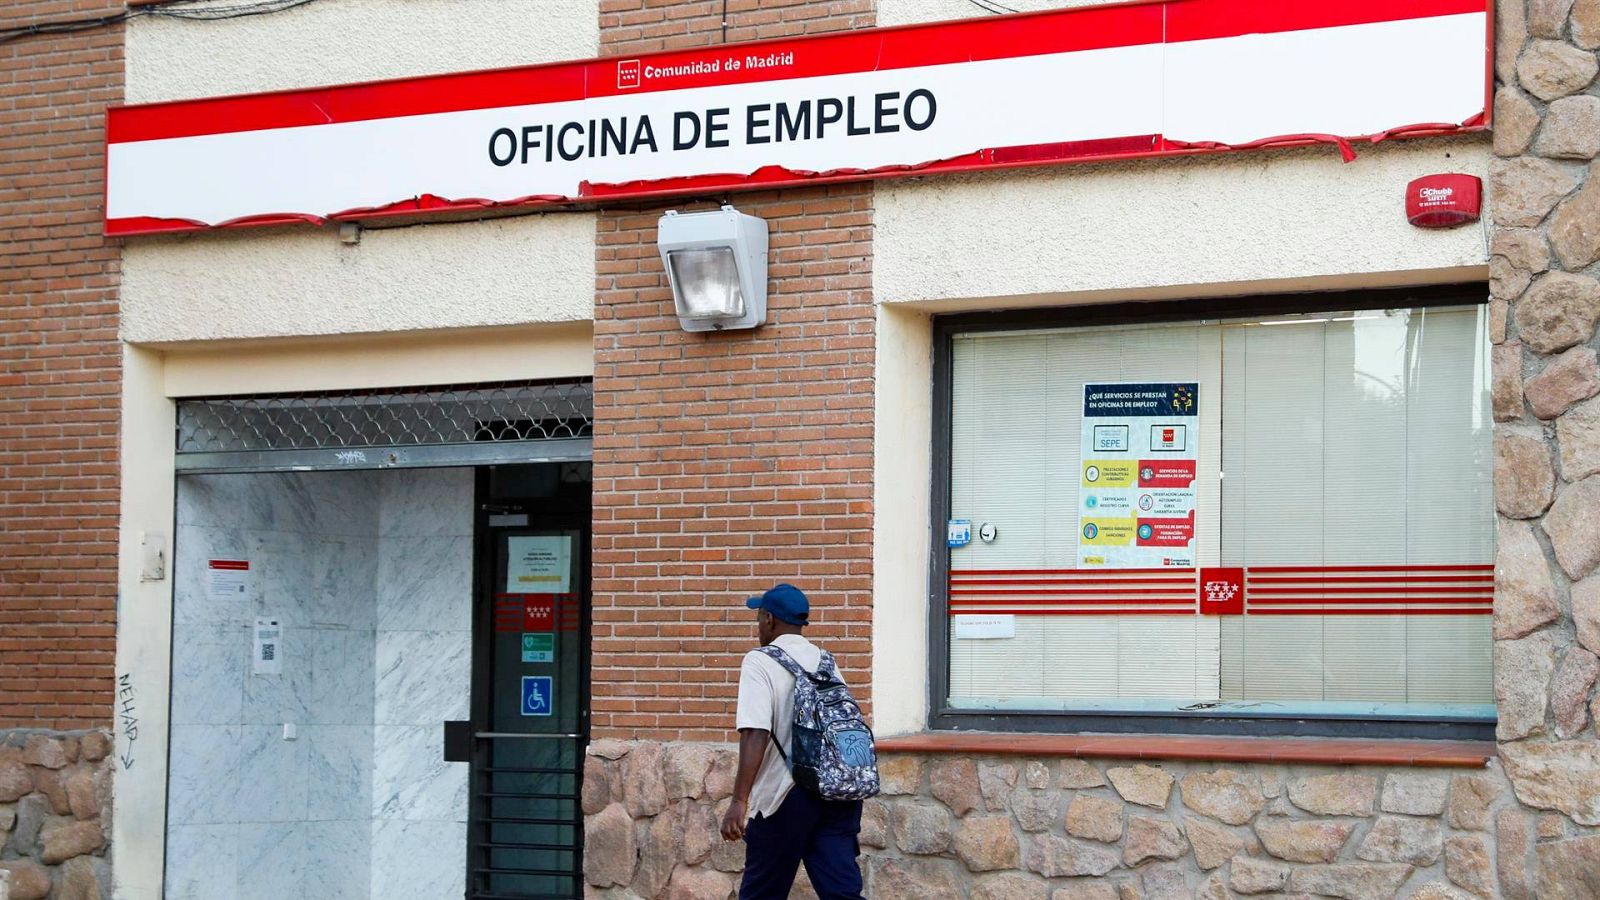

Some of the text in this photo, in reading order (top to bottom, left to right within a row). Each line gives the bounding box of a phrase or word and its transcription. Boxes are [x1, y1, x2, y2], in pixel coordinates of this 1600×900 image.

[644, 51, 794, 79] Comunidad de Madrid
[488, 88, 938, 167] OFICINA DE EMPLEO
[1427, 187, 1453, 197] Chubb
[1089, 393, 1103, 401] ¿QUÉ
[1100, 439, 1121, 448] SEPE
